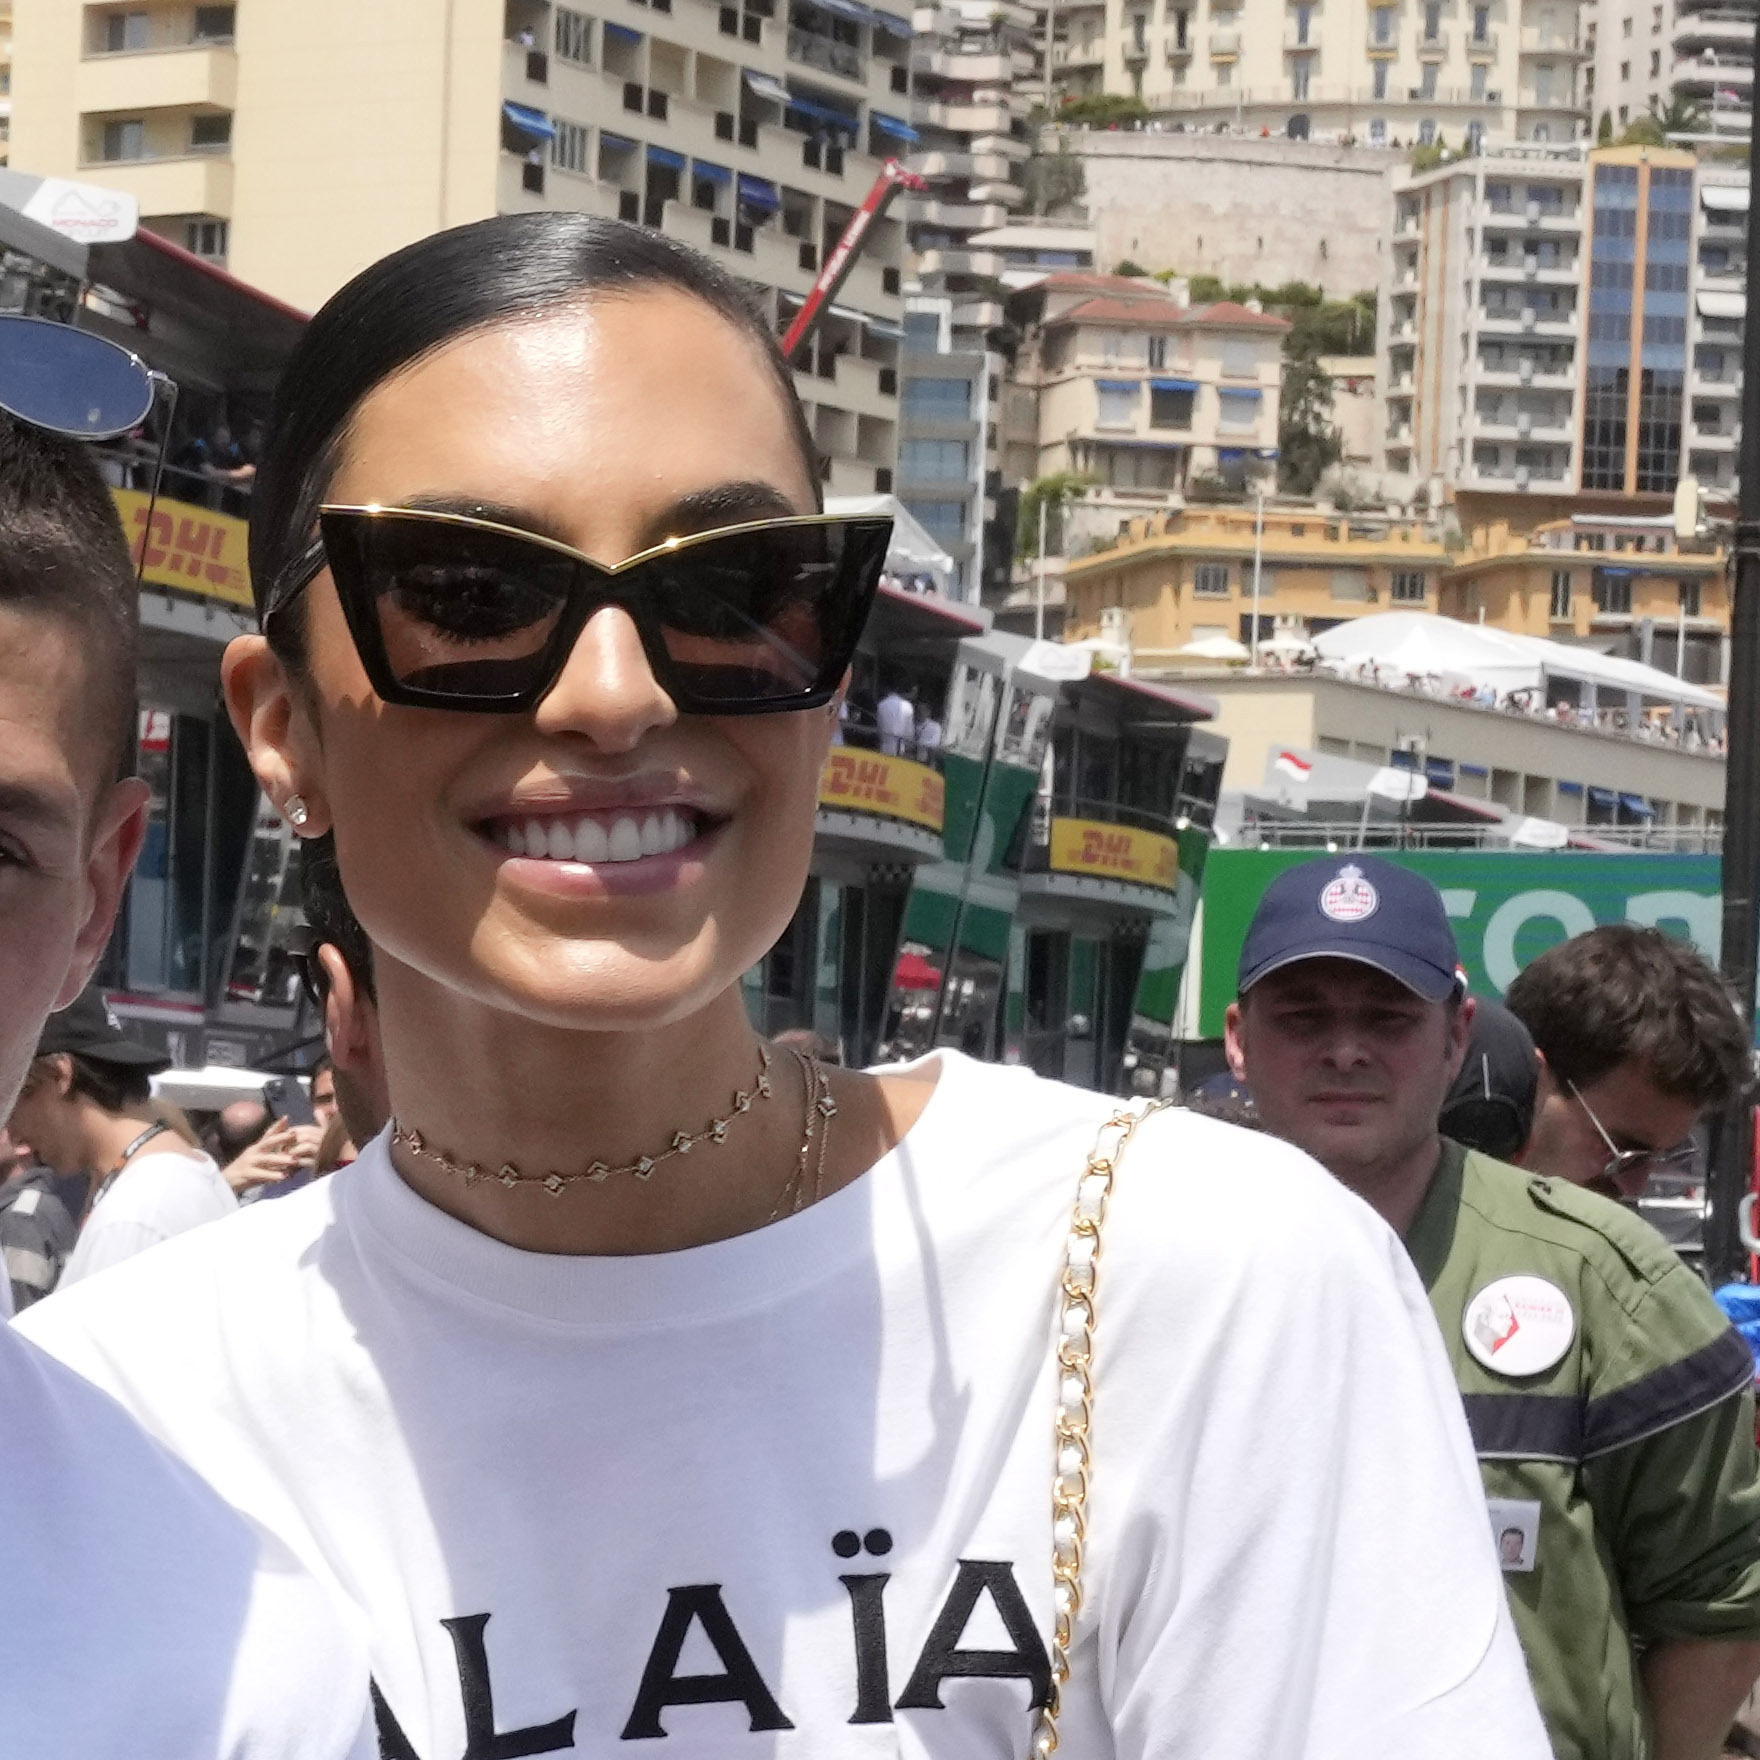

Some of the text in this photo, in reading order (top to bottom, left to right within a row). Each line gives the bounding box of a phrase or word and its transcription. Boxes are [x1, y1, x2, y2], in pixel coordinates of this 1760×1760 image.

[132, 508, 234, 584] DHL
[828, 755, 893, 803] DHL
[1082, 830, 1135, 870] DHL
